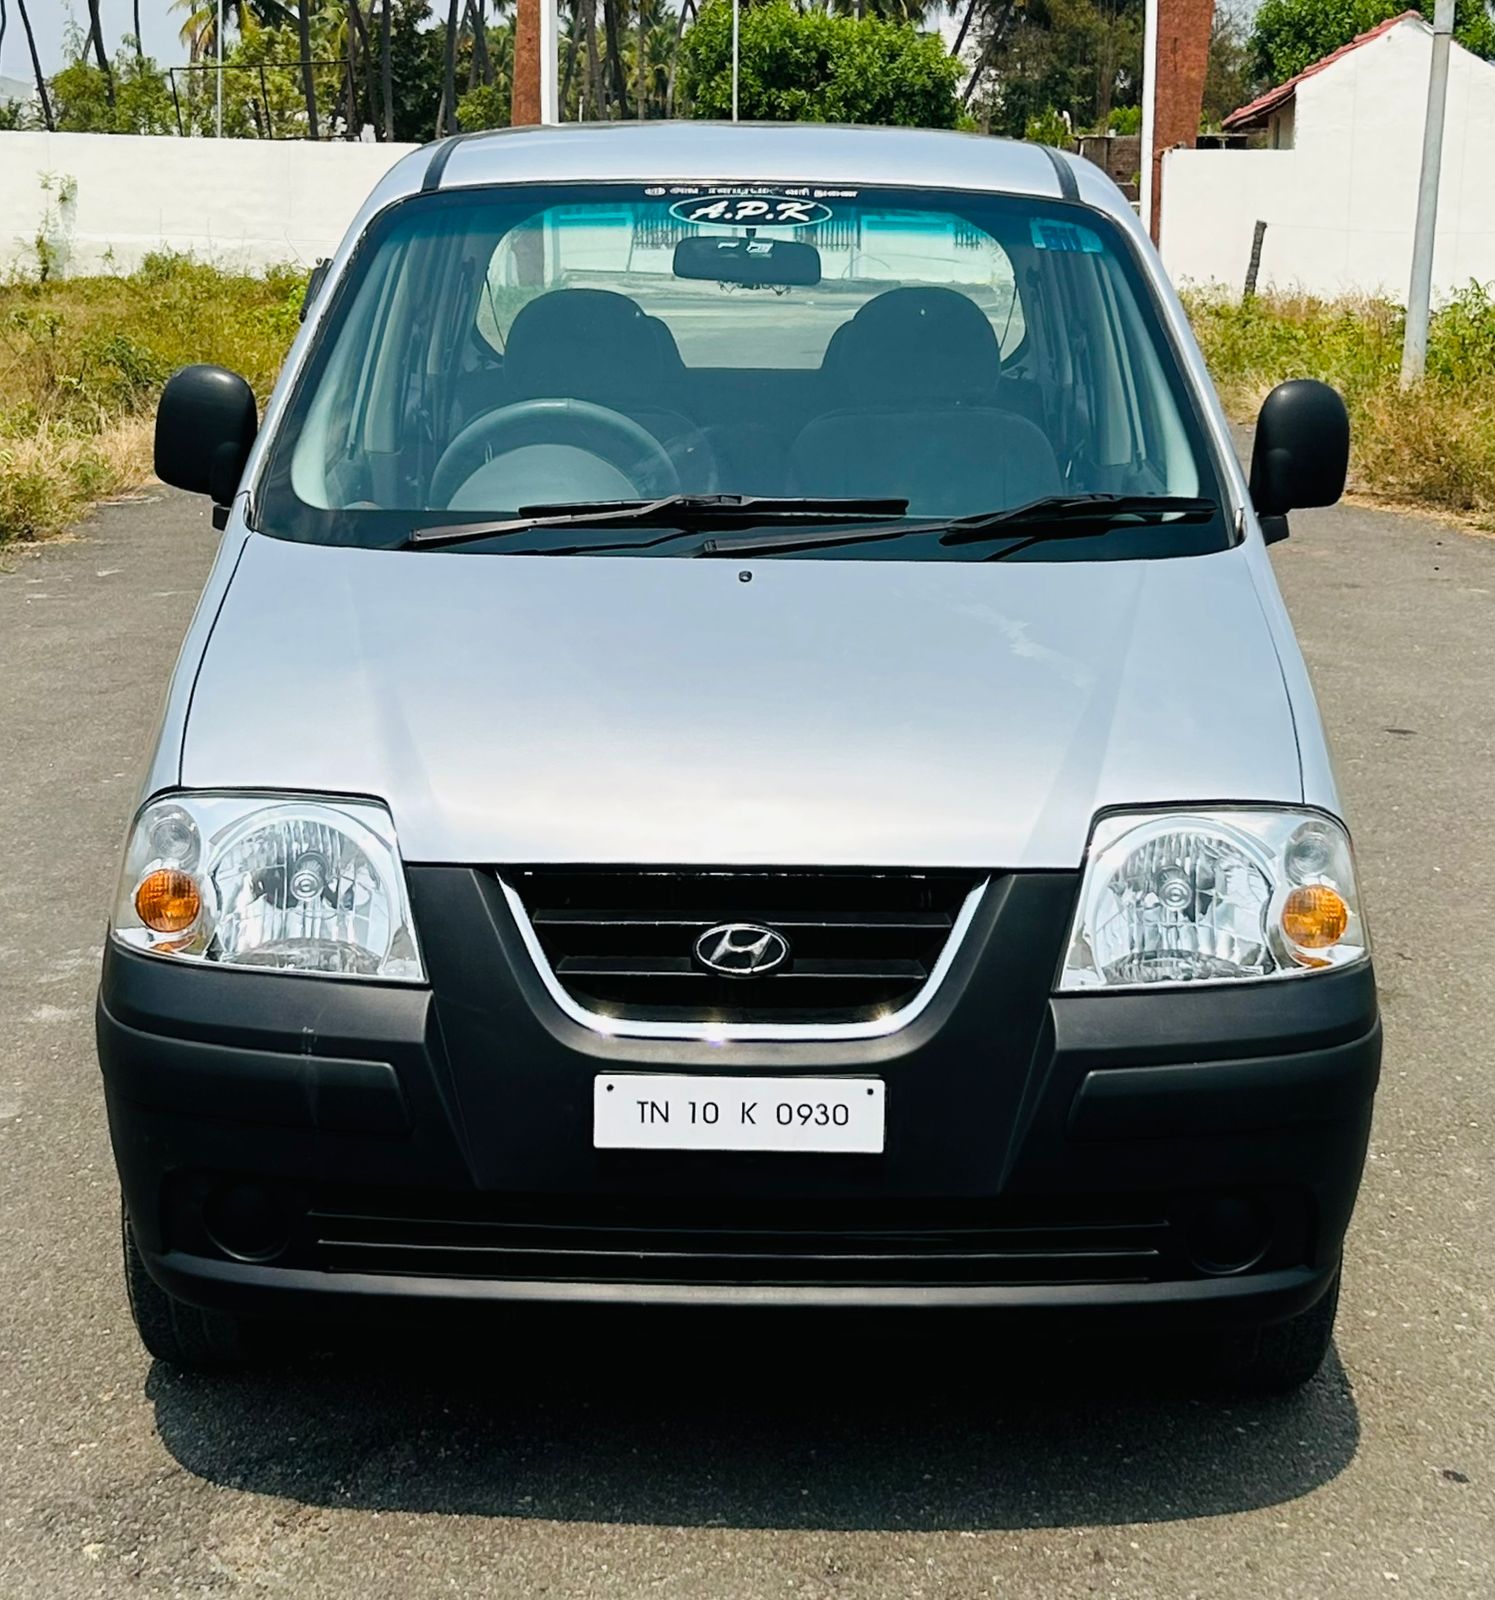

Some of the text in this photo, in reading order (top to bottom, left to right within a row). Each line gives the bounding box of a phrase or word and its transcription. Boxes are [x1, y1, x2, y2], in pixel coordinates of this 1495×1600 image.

[688, 200, 818, 222] A.P.K
[636, 1100, 849, 1126] TN 10 K 0930
